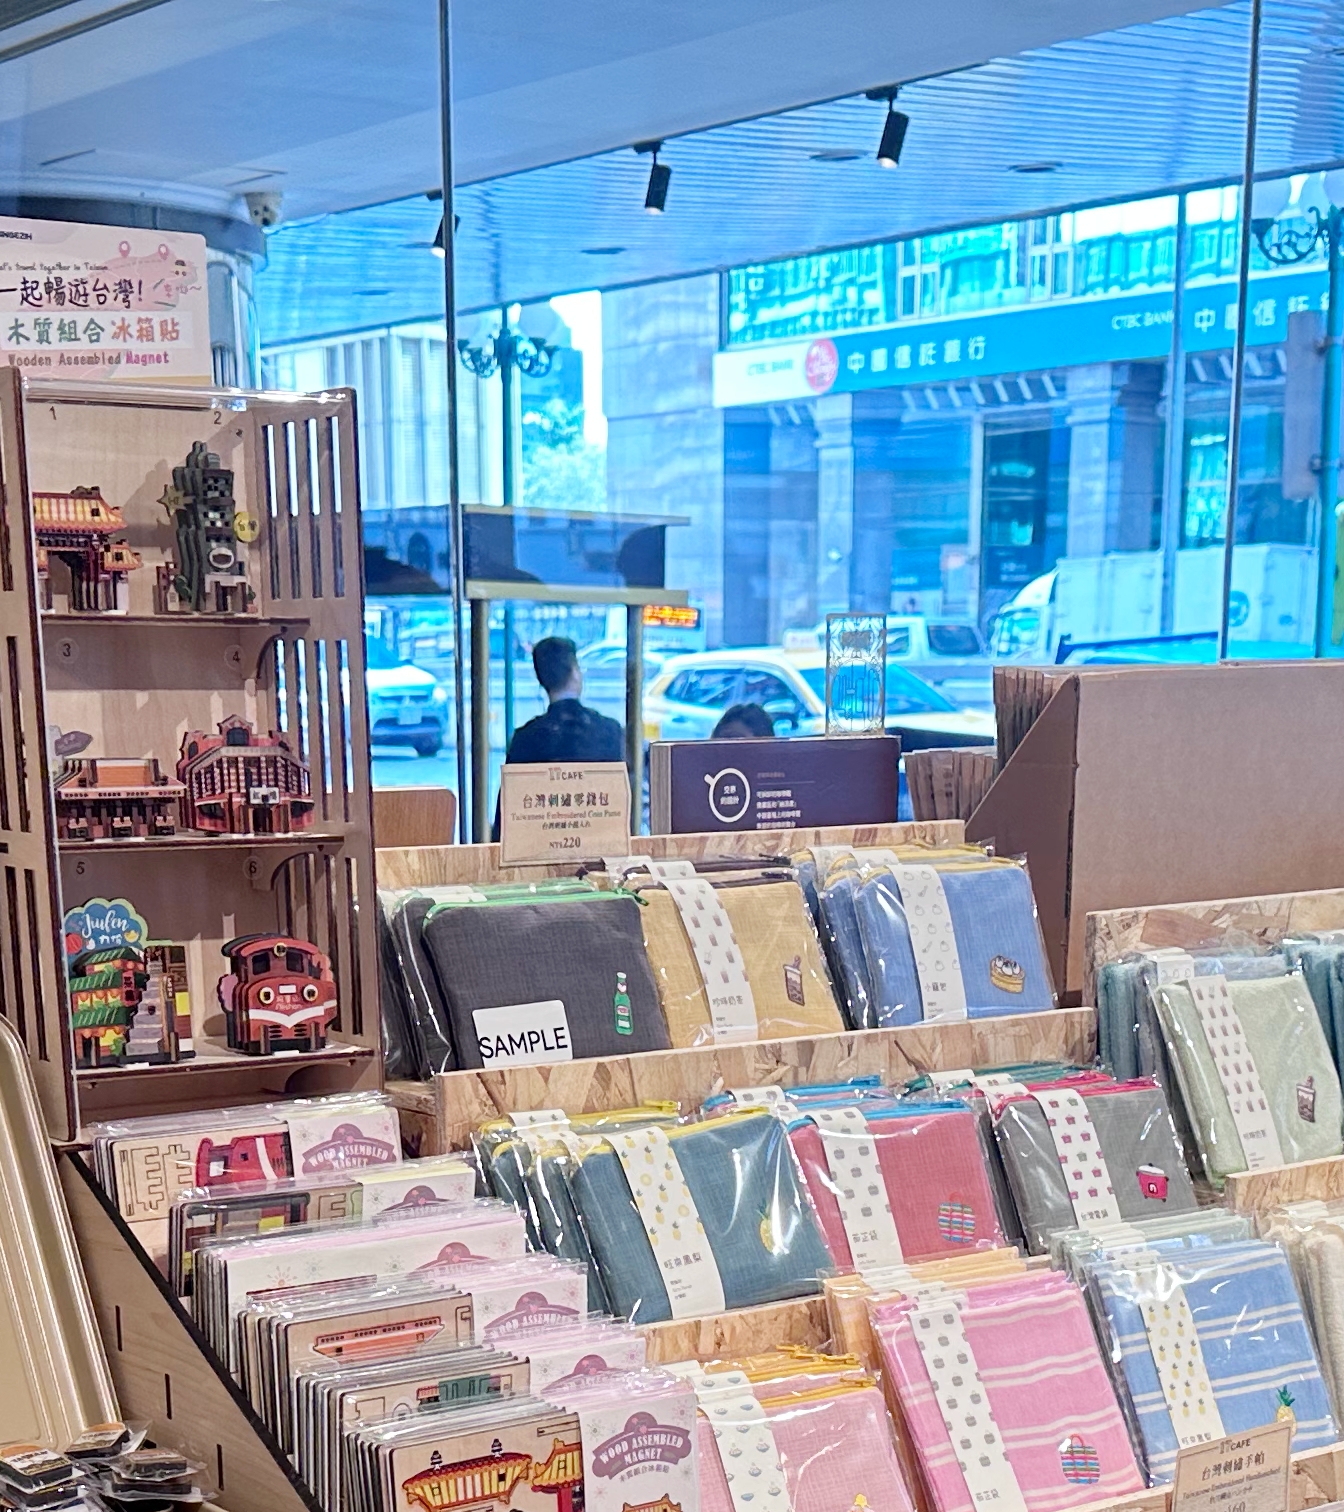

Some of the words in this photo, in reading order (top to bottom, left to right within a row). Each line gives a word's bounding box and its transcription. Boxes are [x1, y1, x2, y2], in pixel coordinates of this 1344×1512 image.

[8, 353, 53, 367] Wooden
[58, 352, 122, 367] Assembled
[125, 350, 170, 367] Magnet
[213, 411, 222, 425] 2
[62, 643, 71, 658] 3
[232, 650, 241, 663] 4
[75, 861, 86, 875] 5
[478, 1025, 568, 1061] SAMPLE
[599, 1440, 629, 1465] WOOD
[631, 1433, 684, 1450] ASSEMBLED
[623, 1447, 663, 1466] MAGNET
[1201, 1450, 1265, 1482] 台灣刺繡手帕
